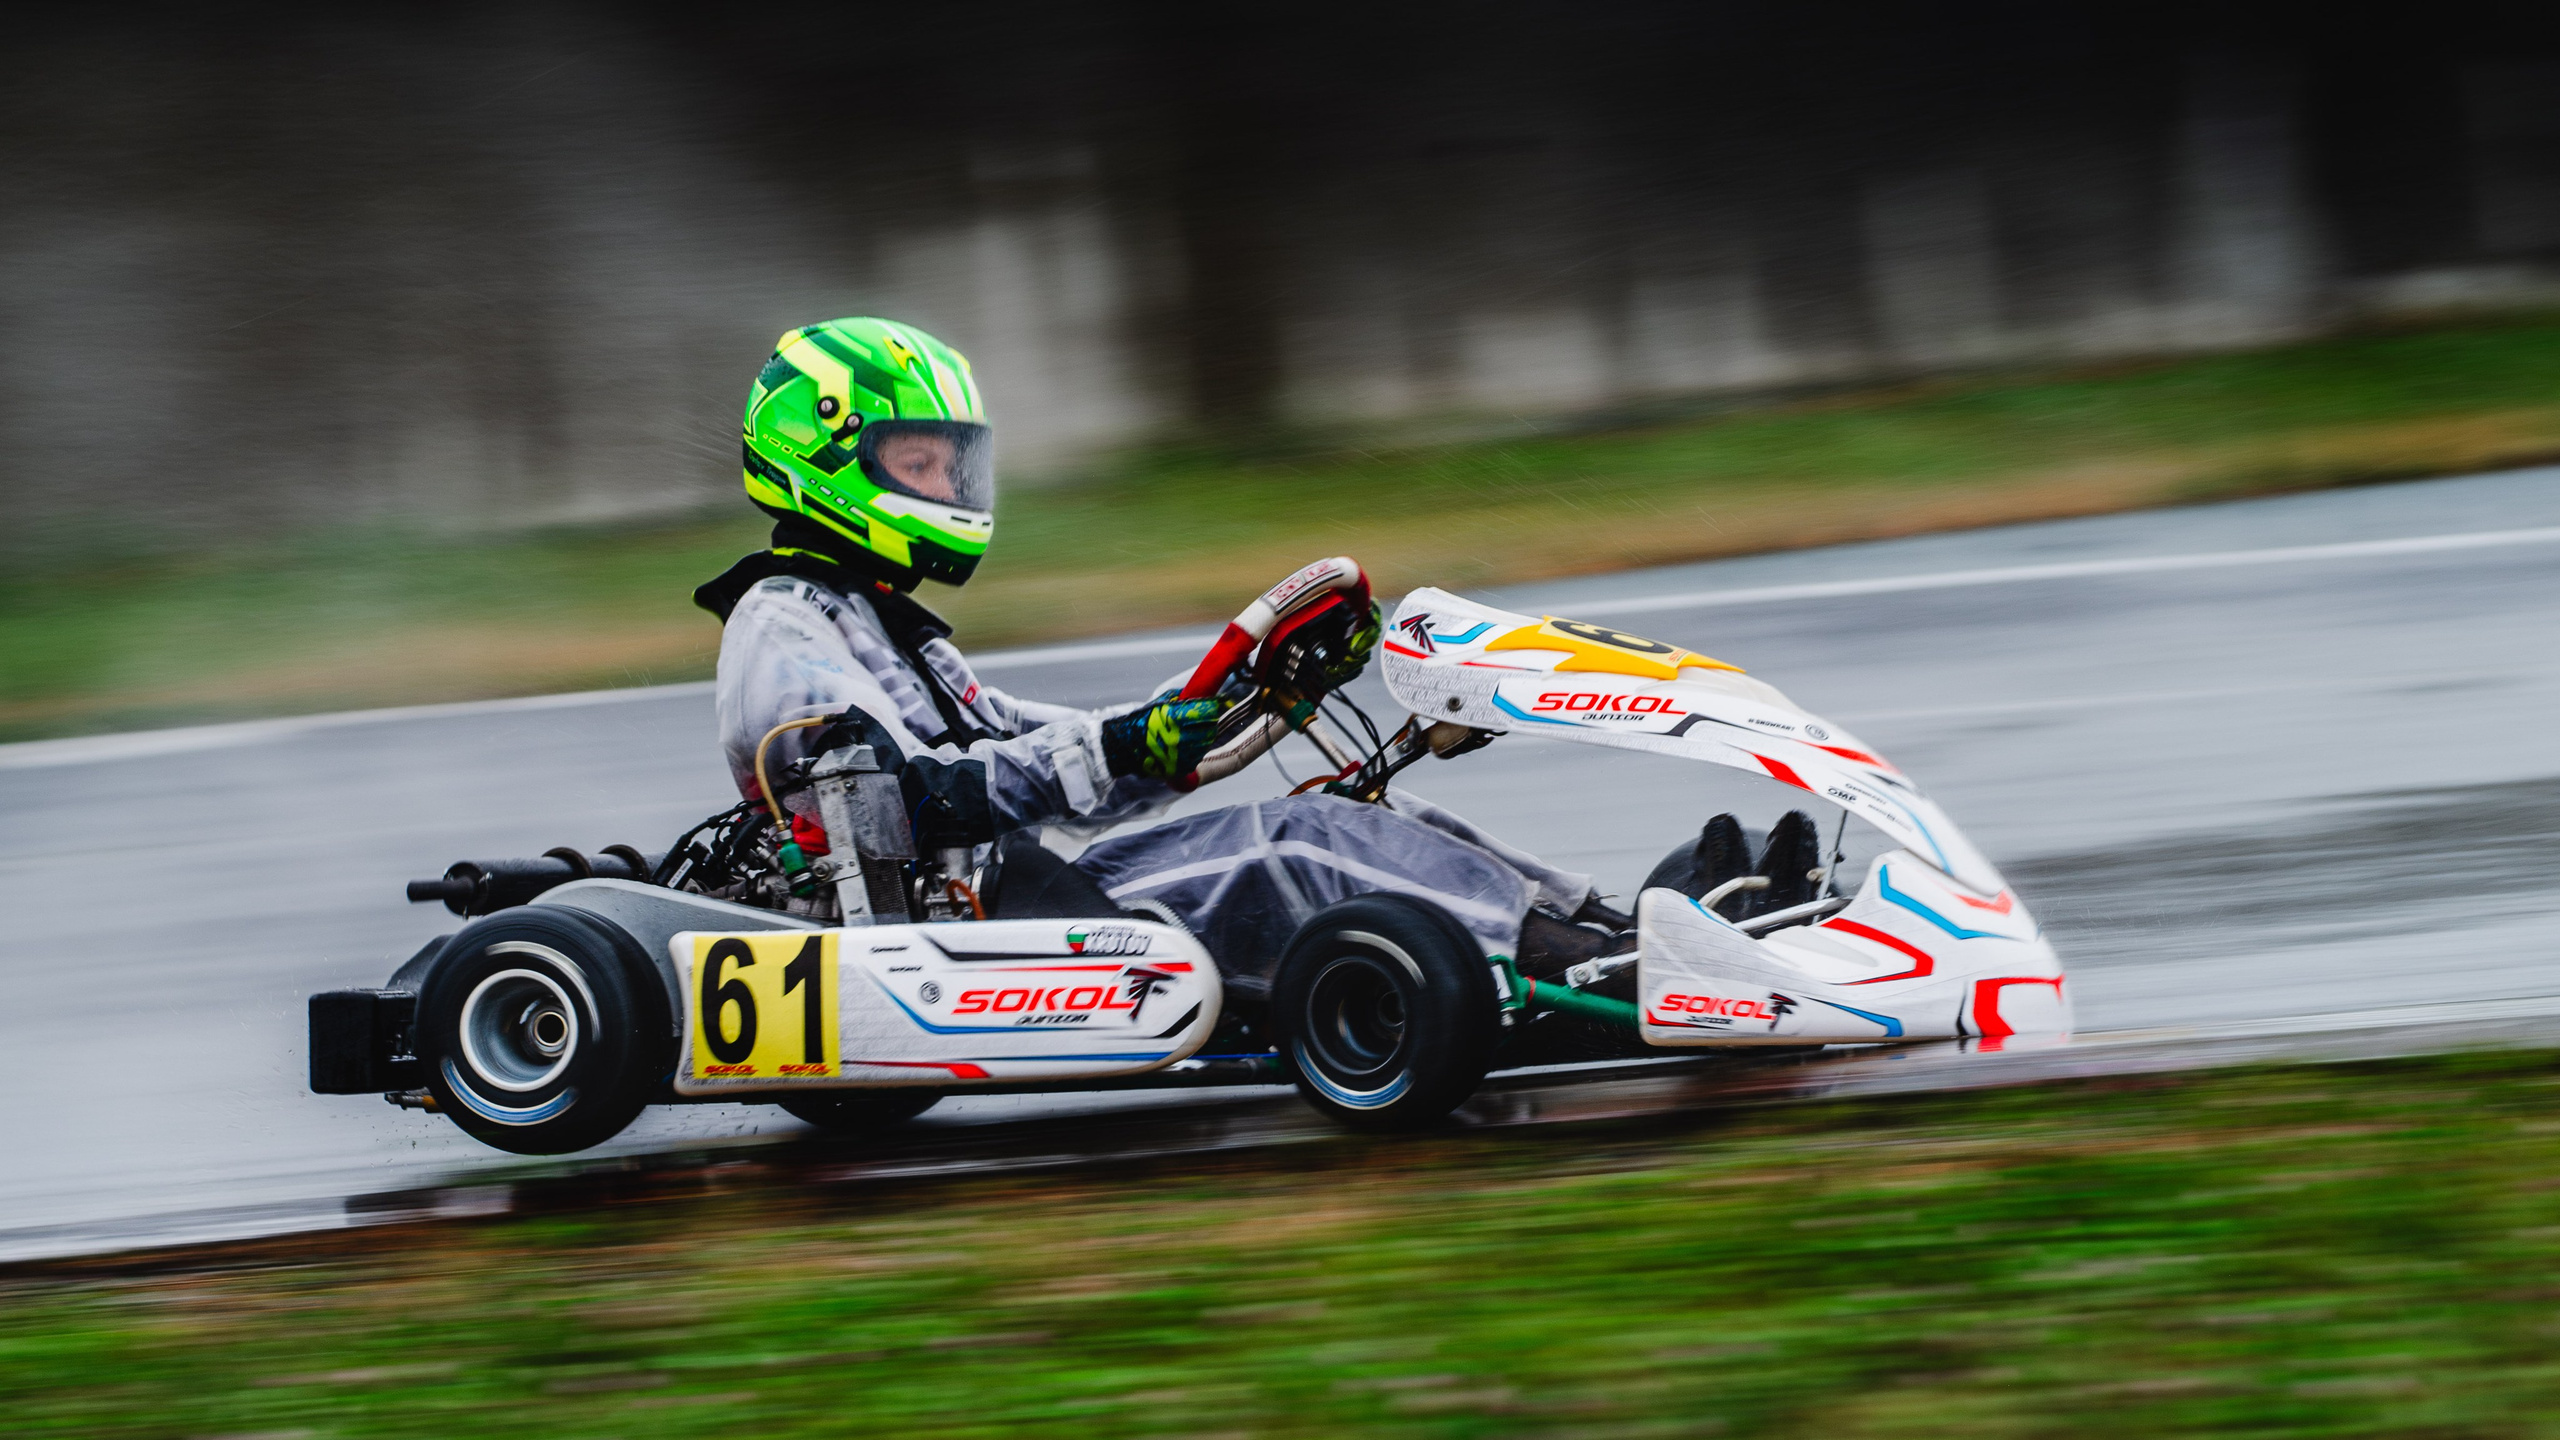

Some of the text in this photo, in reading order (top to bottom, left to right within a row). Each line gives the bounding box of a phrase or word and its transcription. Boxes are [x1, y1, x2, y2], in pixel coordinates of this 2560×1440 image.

[1550, 620, 1674, 655] 6
[1531, 692, 1688, 715] SOKOL
[1582, 712, 1646, 721] JUNIOR
[1828, 787, 1857, 803] OMP
[702, 936, 825, 1065] 61
[951, 985, 1137, 1015] SOKOL
[1656, 993, 1778, 1020] SOKOL
